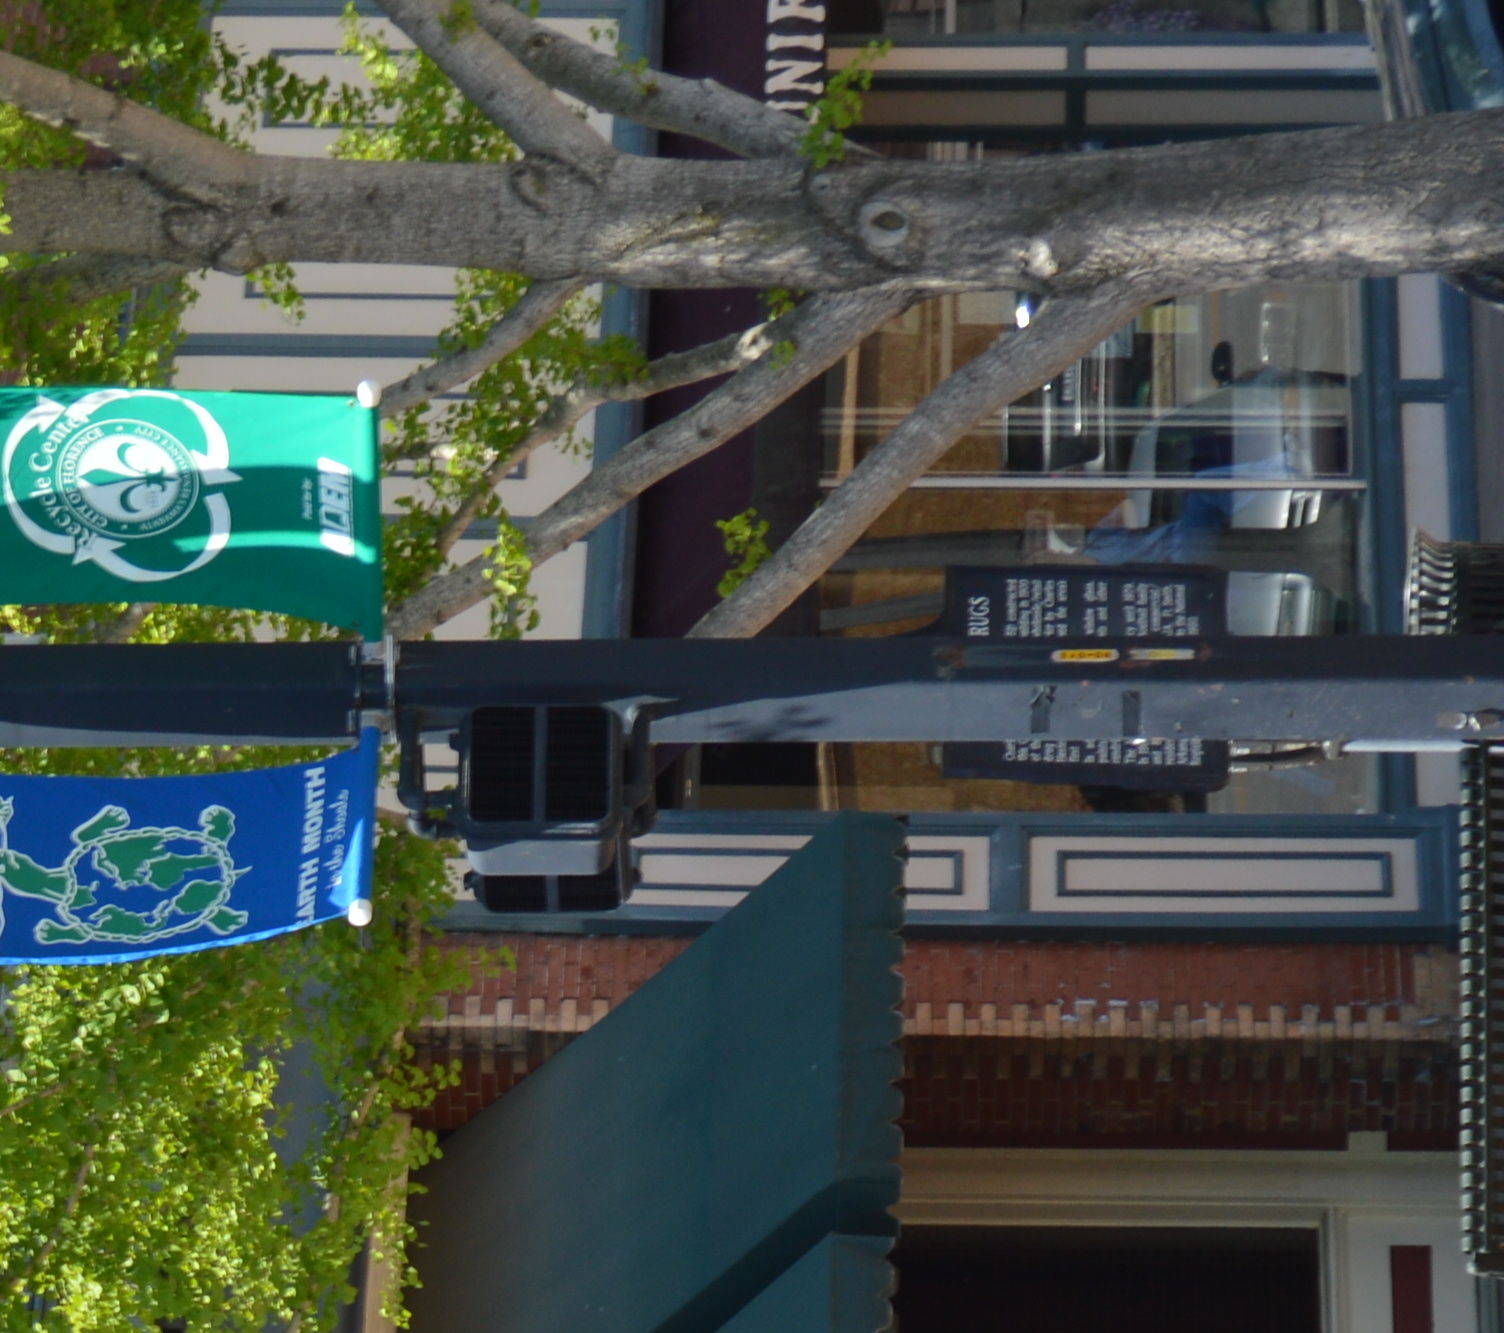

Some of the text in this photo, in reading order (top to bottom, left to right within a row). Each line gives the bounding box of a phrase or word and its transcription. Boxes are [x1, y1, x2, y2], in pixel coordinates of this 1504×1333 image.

[63, 427, 108, 528] CITY OF FLORENCE
[317, 457, 354, 556] ADEM
[967, 596, 990, 637] RUGS
[301, 766, 326, 854] MONTH
[323, 789, 350, 843] Shoals
[322, 844, 345, 870] the
